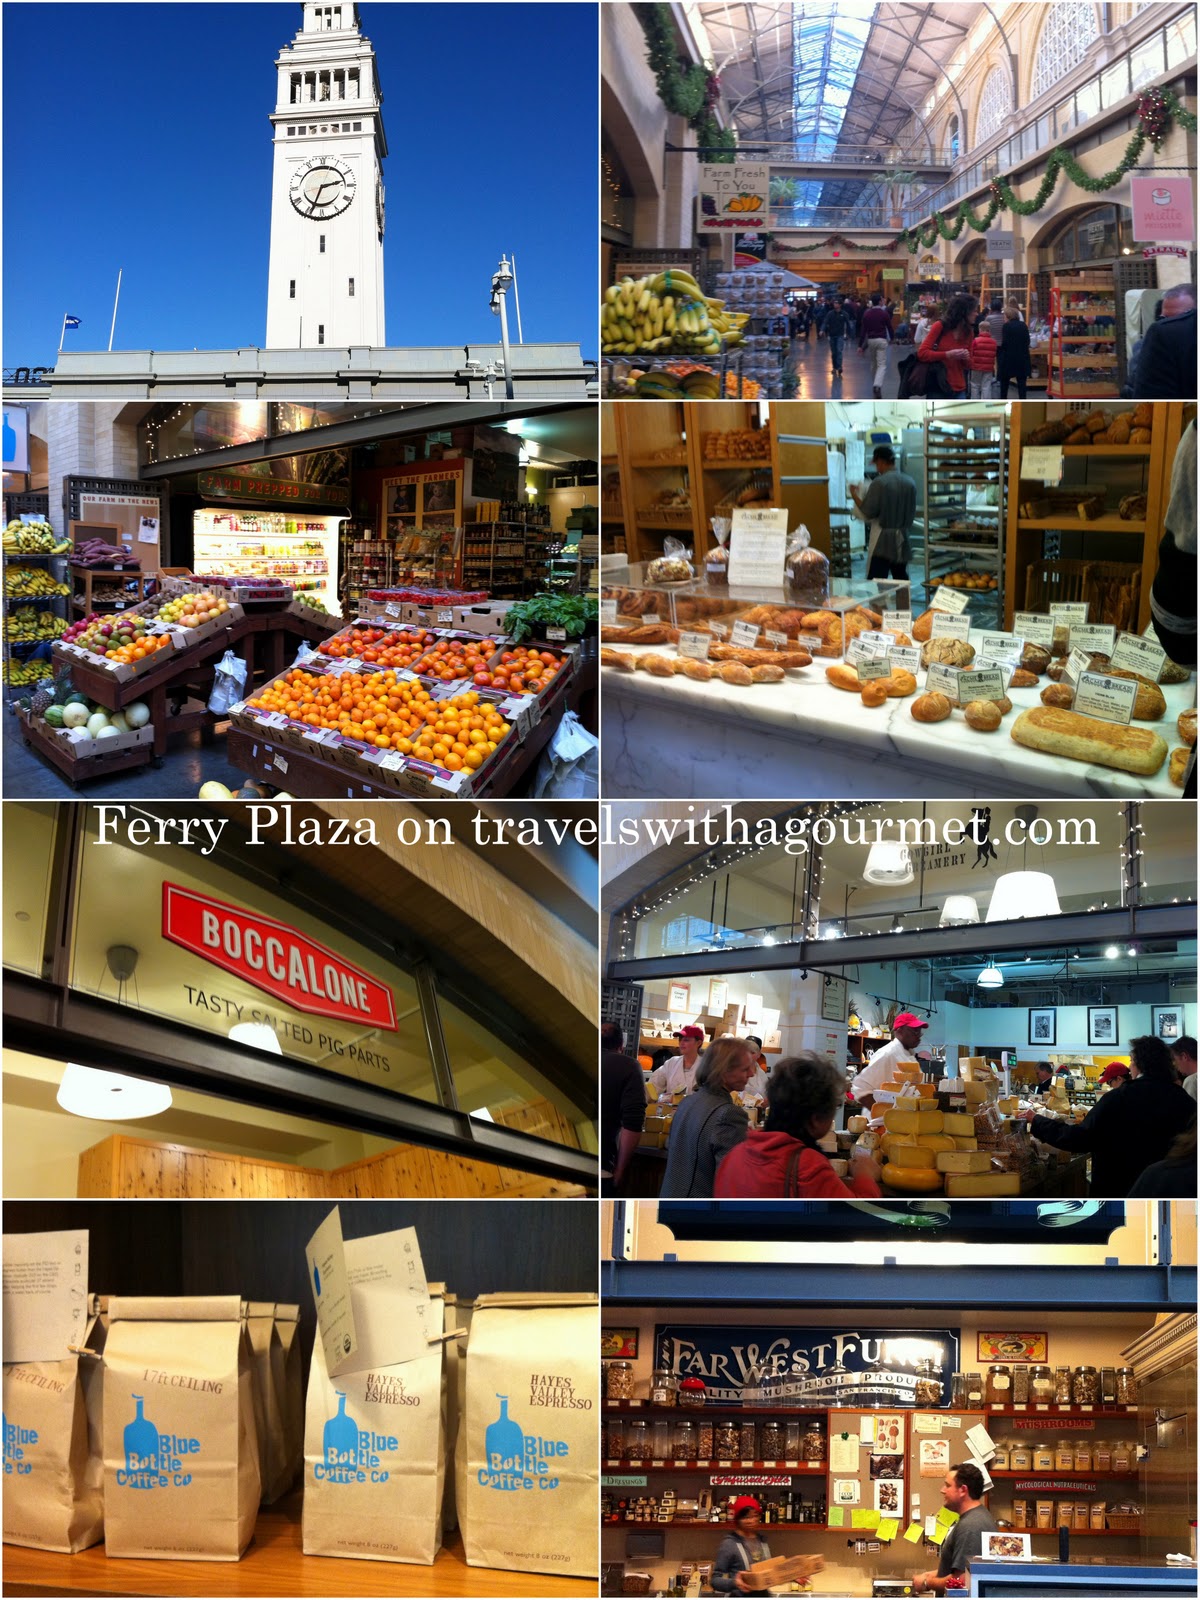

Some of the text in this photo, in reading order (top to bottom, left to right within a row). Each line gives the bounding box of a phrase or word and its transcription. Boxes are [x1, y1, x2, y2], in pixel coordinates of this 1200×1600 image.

[703, 166, 766, 178] Farm Fresh
[712, 179, 755, 191] To You
[206, 475, 242, 492] FARM
[247, 480, 299, 497] PREPPED
[304, 488, 321, 499] FOR
[384, 471, 460, 487] MEET THE FARMERS
[900, 843, 951, 861] COWGIRL
[905, 853, 966, 873] CREAMERY
[202, 909, 371, 1014] BOCCALONE
[183, 984, 391, 1072] TASTY SALTED PIG PARTS
[671, 1336, 745, 1389] FAR
[731, 1337, 832, 1386] WEST
[26, 1373, 66, 1393] CEILING
[170, 1375, 224, 1395] CEILING
[366, 1383, 407, 1396] VALLEY
[367, 1373, 403, 1386] HAYES
[530, 1374, 572, 1388] HAYES
[364, 1392, 421, 1407] ESPRESSO
[530, 1385, 576, 1399] VALLEY
[529, 1395, 592, 1410] ESPRESSO
[1016, 1419, 1092, 1429] MUSHROOMS
[7, 1424, 39, 1446] Blue
[159, 1434, 201, 1456] Blue
[358, 1431, 399, 1452] Blue
[524, 1435, 569, 1458] Blue
[17, 1462, 32, 1474] co
[129, 1452, 182, 1473] Bottle
[327, 1447, 381, 1469] Bottle
[490, 1452, 549, 1475] Bottle
[116, 1469, 193, 1488] Coffee co
[314, 1463, 390, 1484] Coffee co
[477, 1469, 560, 1491] Coffee co
[1015, 1481, 1097, 1492] MYCOLOGICAL NUTRACEUTICALS
[515, 1552, 535, 1560] weight
[551, 1554, 571, 1562] (227g)
